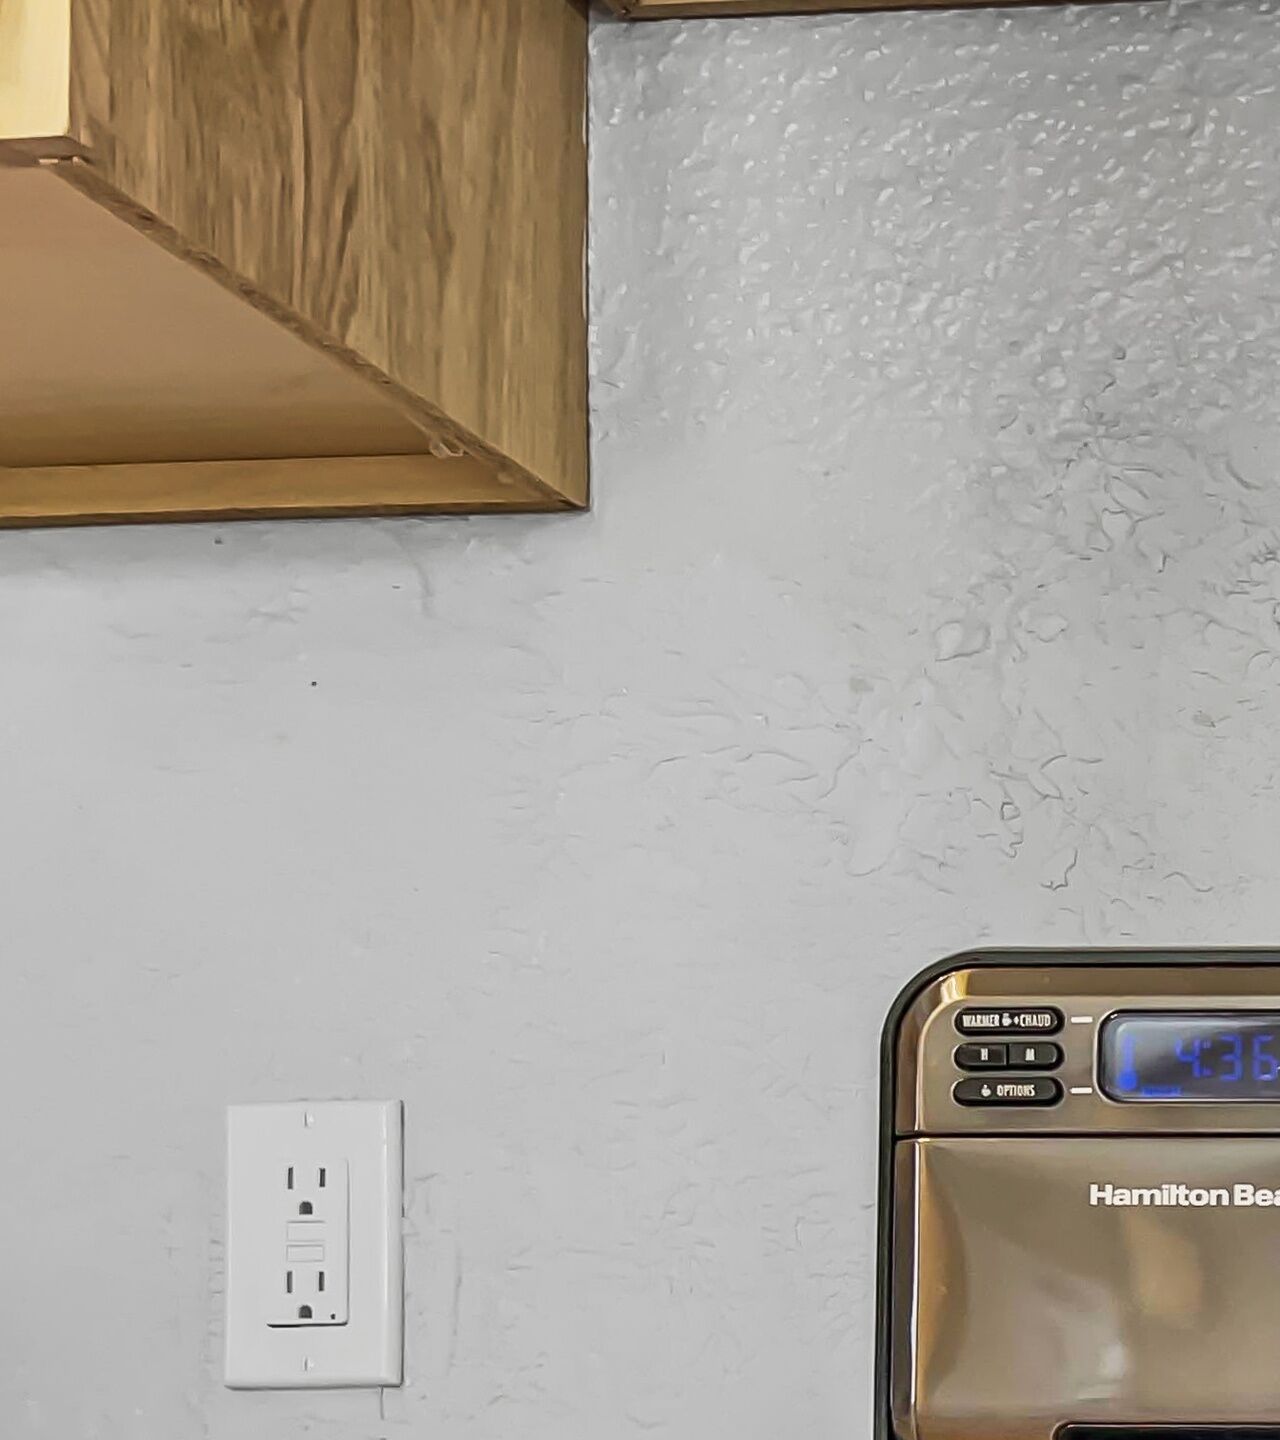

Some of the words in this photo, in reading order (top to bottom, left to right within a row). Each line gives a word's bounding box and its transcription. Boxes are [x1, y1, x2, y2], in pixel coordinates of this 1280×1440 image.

[1020, 1013, 1052, 1027] CHAUD
[1174, 1032, 1280, 1082] 4:36
[996, 1084, 1036, 1097] OPTIONS
[1089, 1184, 1230, 1207] Hamilton
